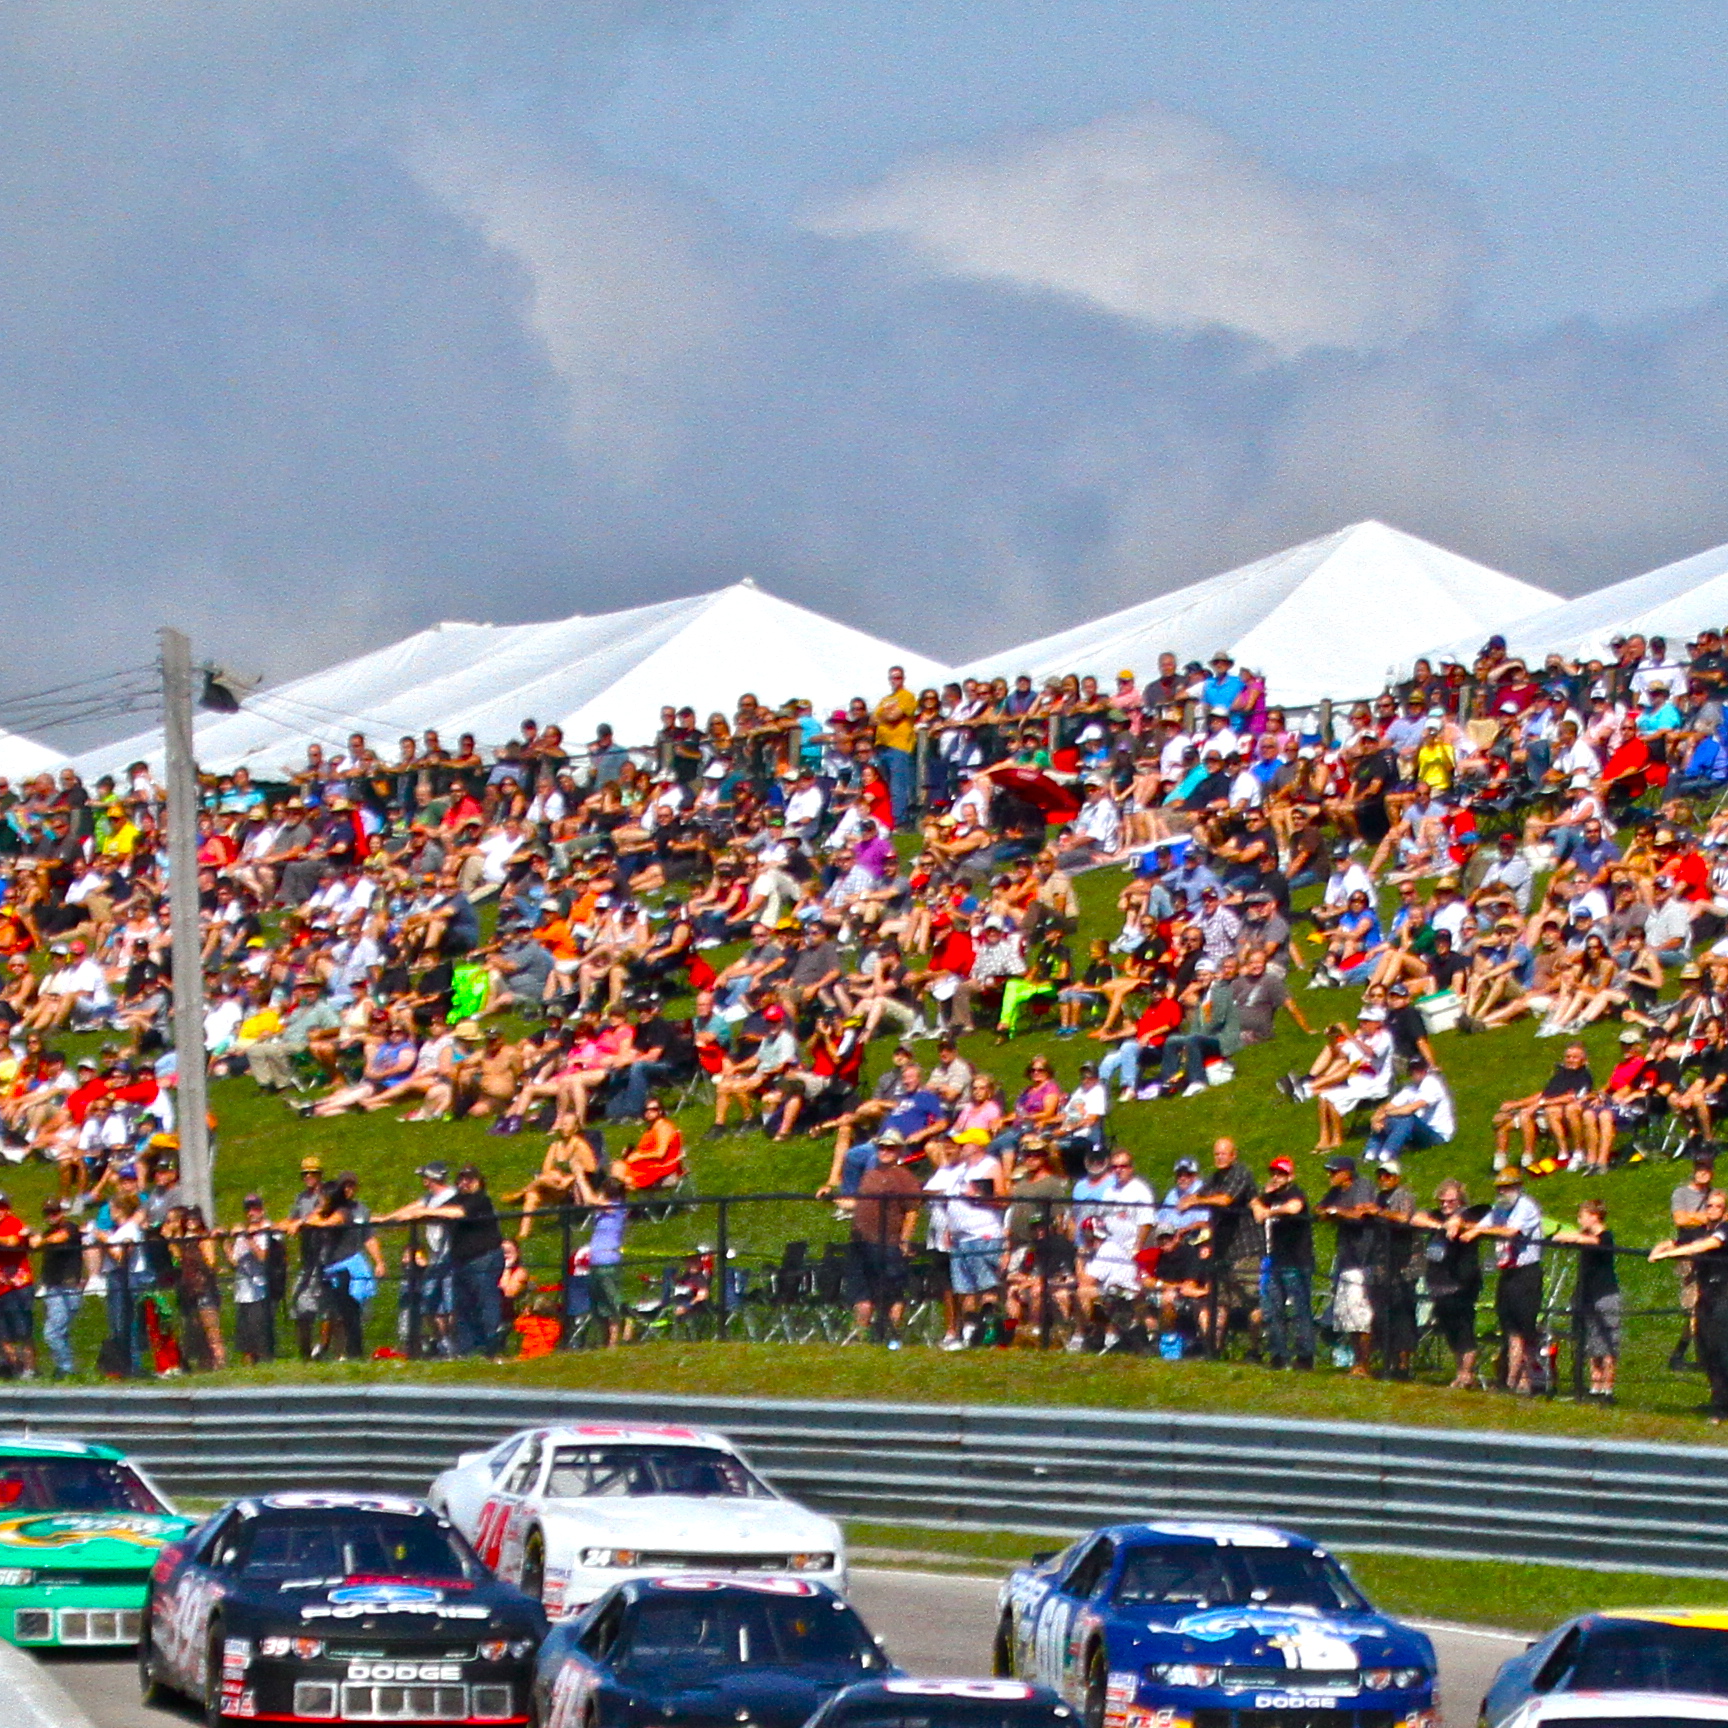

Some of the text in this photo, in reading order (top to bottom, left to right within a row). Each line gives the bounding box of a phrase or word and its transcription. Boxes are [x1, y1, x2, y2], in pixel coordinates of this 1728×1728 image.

[584, 1550, 612, 1565] 24
[301, 1603, 491, 1619] POLARIS
[263, 1637, 290, 1655] 39
[348, 1665, 463, 1680] DODGE
[1255, 1695, 1337, 1709] DODGE
